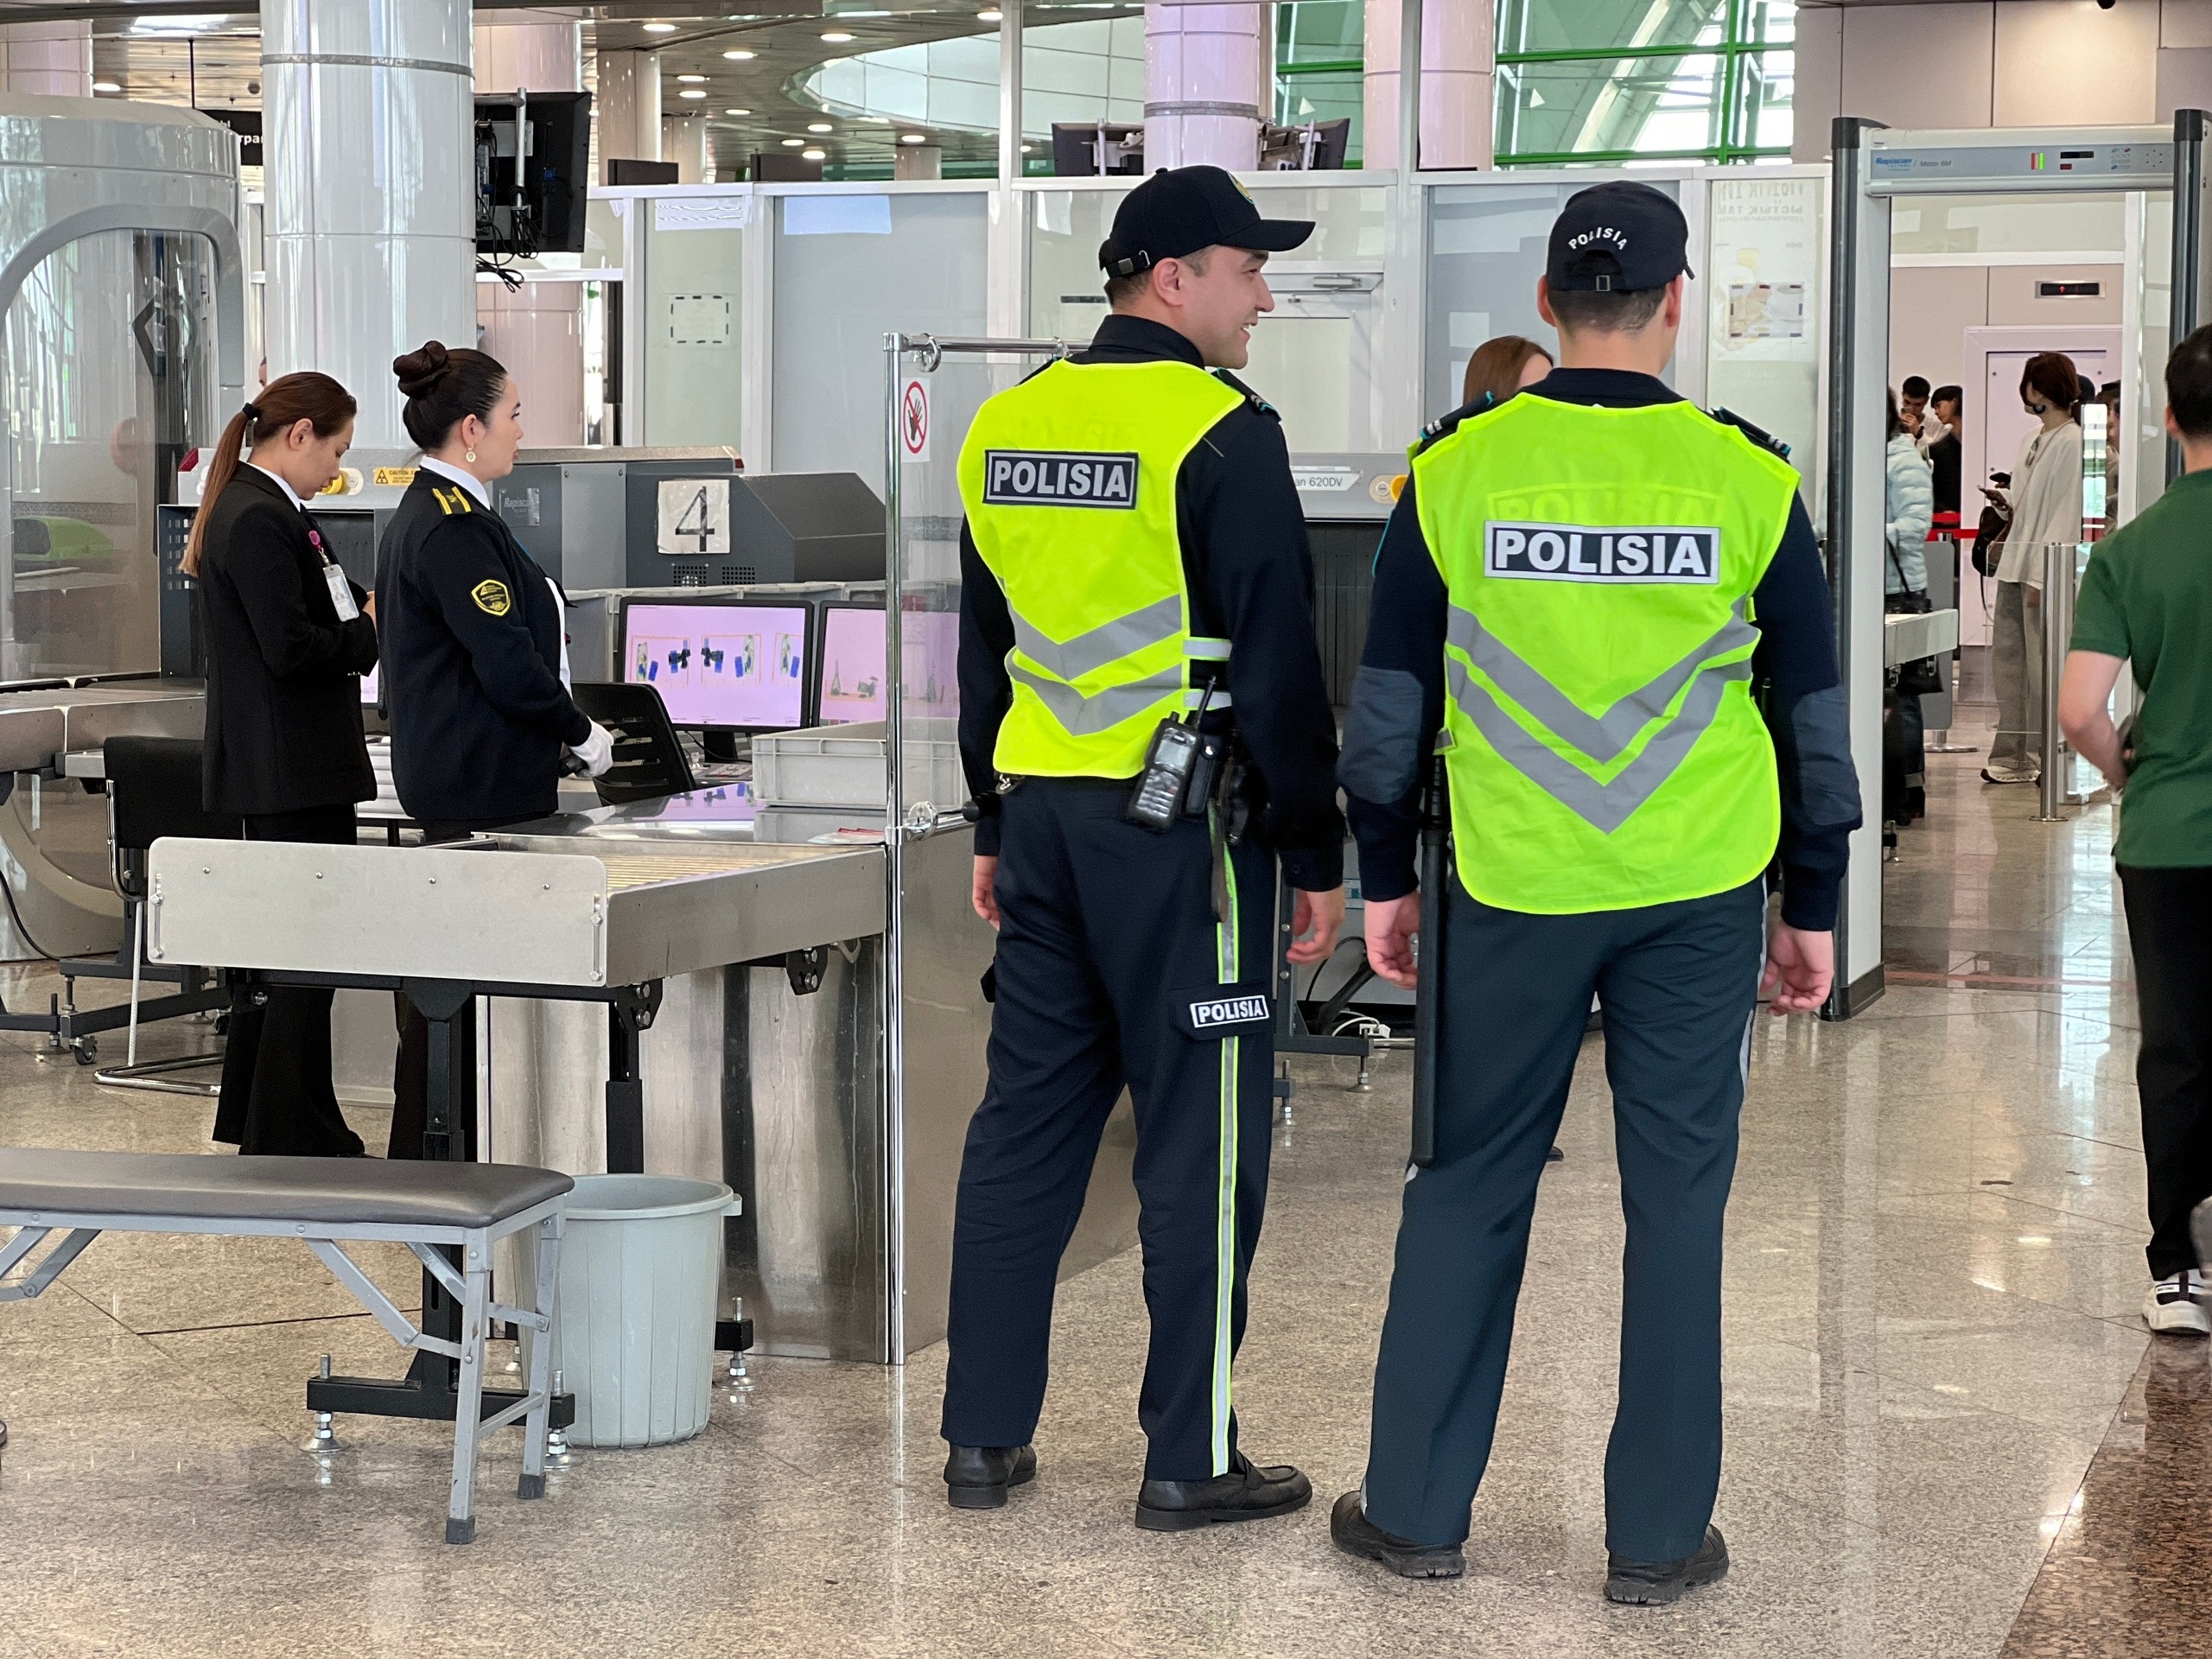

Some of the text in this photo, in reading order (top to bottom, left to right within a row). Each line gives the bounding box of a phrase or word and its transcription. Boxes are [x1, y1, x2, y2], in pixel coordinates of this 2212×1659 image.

[1875, 156, 1913, 166] Rapiscan
[1567, 226, 1628, 250] POLISIA
[993, 460, 1128, 498] POLISIA
[1309, 477, 1343, 487] 620DV
[504, 497, 535, 510] Rapisca
[675, 486, 715, 552] 4
[1495, 529, 1707, 575] POLISIA
[1198, 999, 1264, 1023] POLISIA
